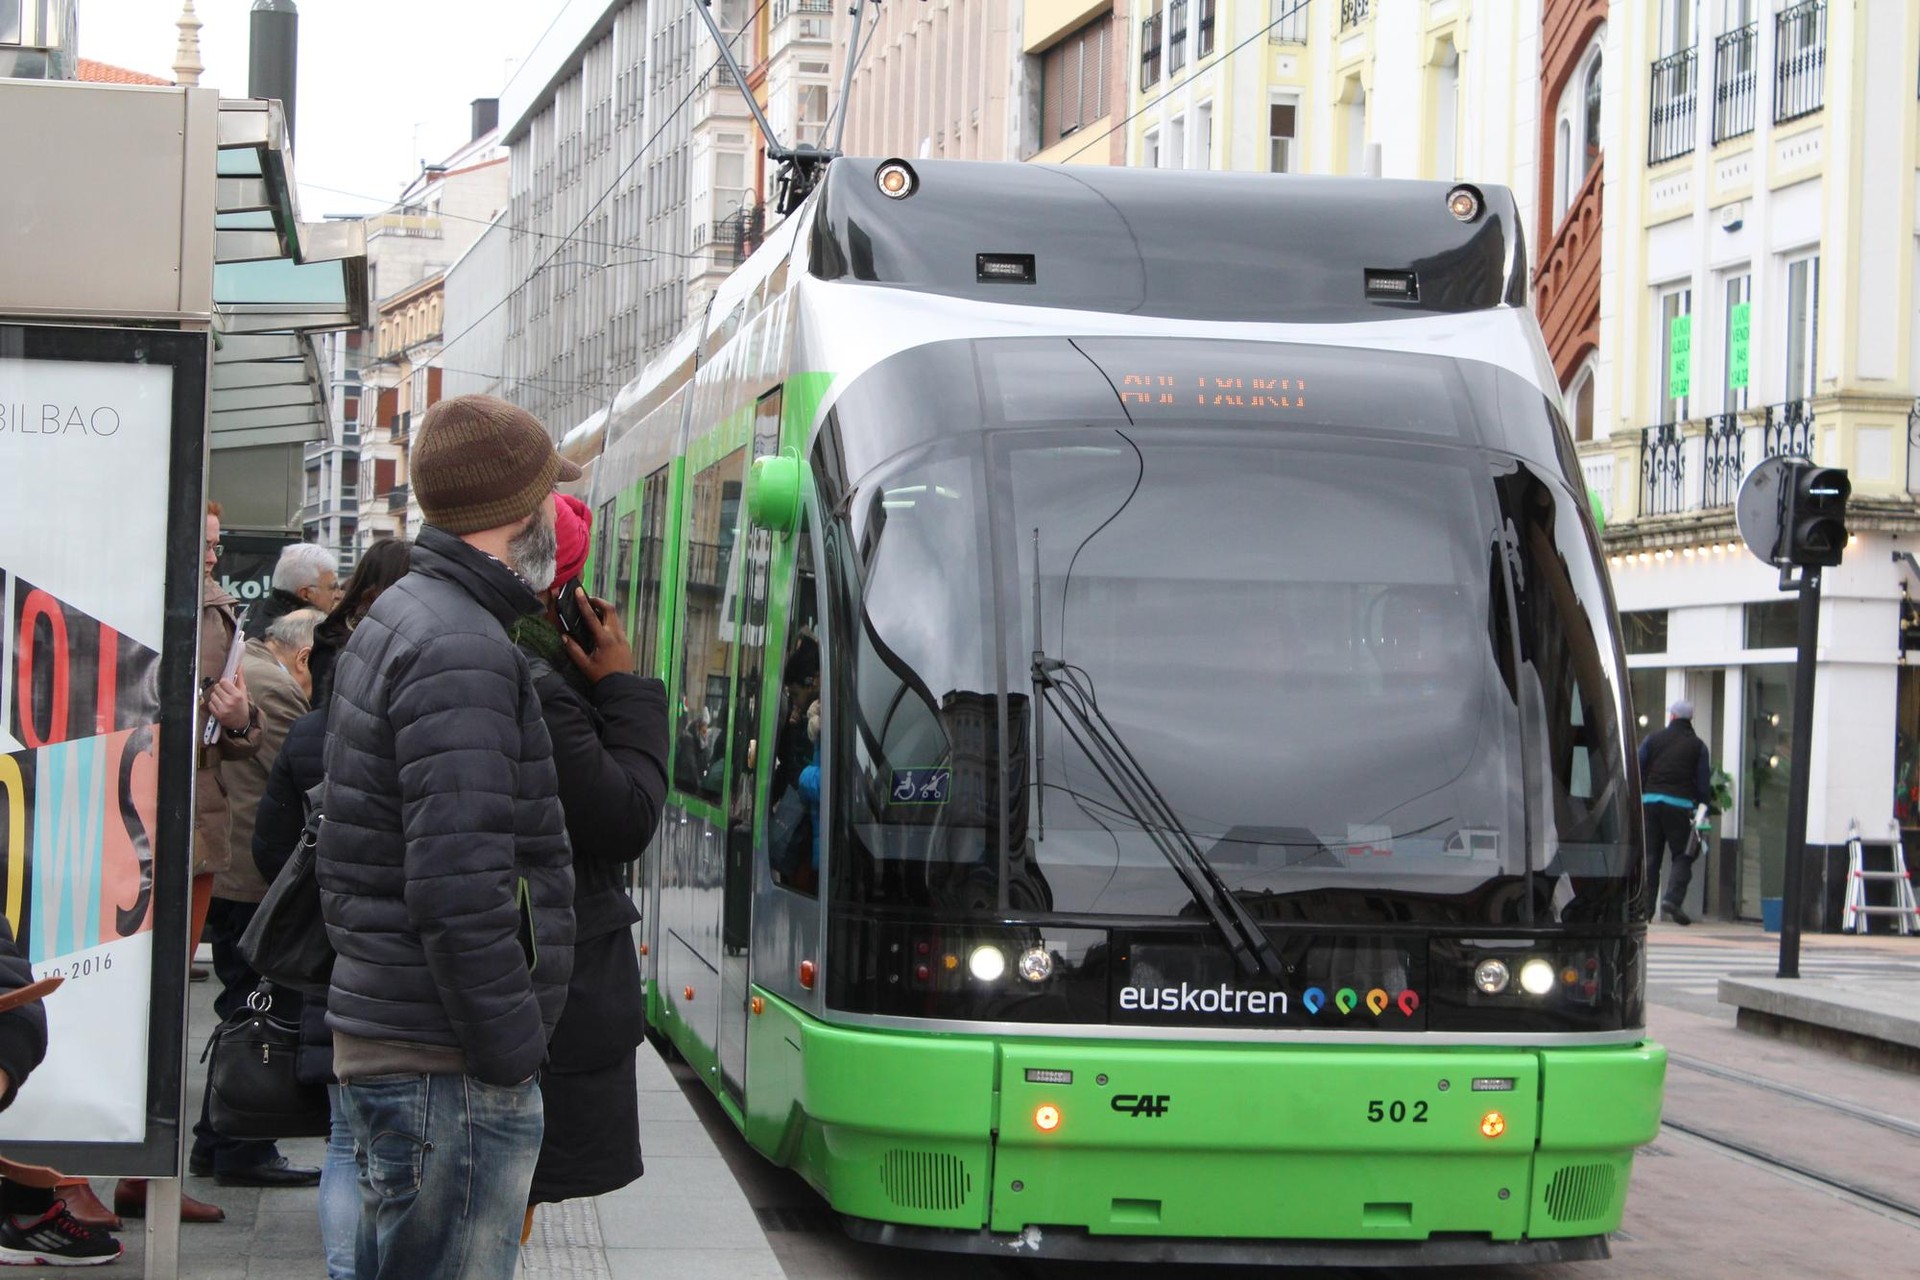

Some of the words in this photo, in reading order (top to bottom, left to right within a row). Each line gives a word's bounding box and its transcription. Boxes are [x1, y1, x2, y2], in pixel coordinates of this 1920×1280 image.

[1119, 982, 1288, 1015] euskotren
[1110, 1094, 1170, 1117] CAF
[1367, 1100, 1429, 1123] 502
